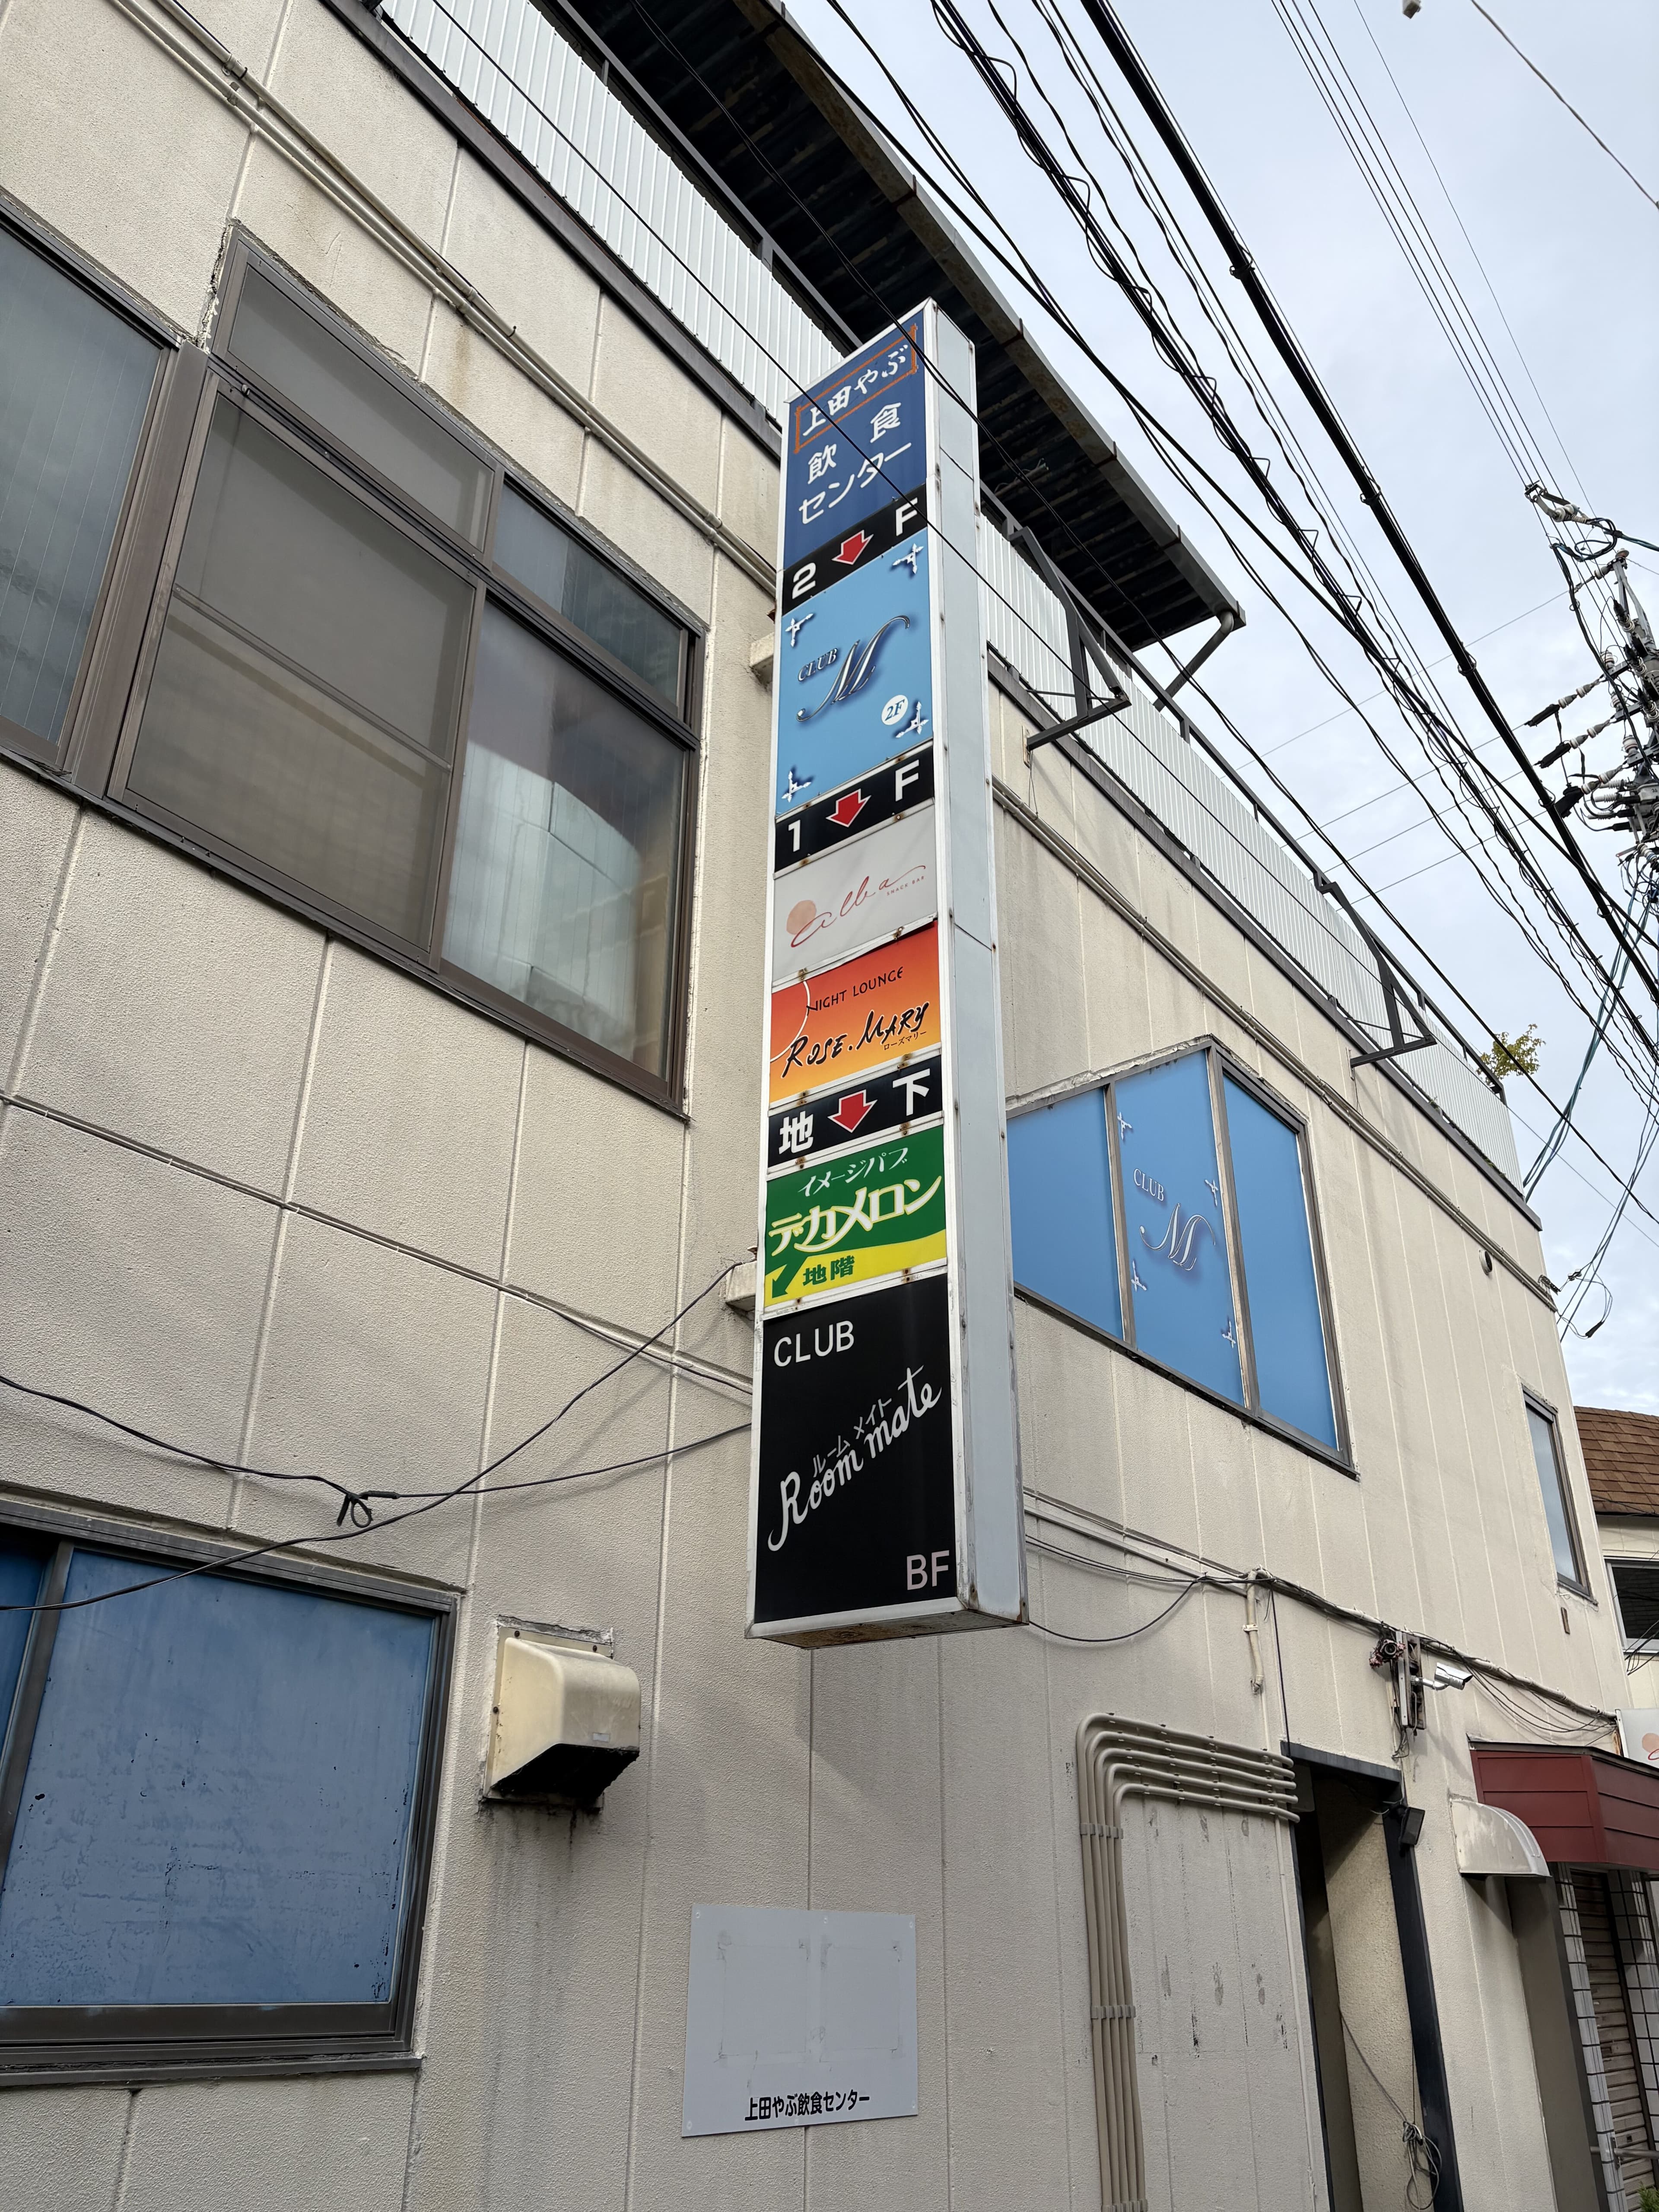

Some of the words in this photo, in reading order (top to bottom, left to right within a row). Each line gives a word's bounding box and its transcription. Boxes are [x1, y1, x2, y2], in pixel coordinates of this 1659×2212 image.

[802, 344, 908, 436] 上田やぶ
[798, 442, 912, 524] センター
[796, 615, 910, 722] M
[798, 648, 838, 682] CLUB
[884, 699, 905, 721] 2F
[887, 883, 908, 896] SNACK
[912, 875, 925, 884] BAR
[806, 990, 847, 1016] NIGHT
[853, 966, 903, 997] LOUNGE
[884, 1031, 927, 1050] ローズマリー
[798, 1147, 908, 1197] イメージパブ
[1133, 1168, 1164, 1202] CLUB
[768, 1176, 942, 1256] デカメロン
[1139, 1202, 1216, 1271] M
[802, 1255, 855, 1286] 地階
[774, 1320, 855, 1367] CLUB
[907, 1550, 950, 1590] BF
[744, 2089, 870, 2121] 上田やぶ飲食センター
